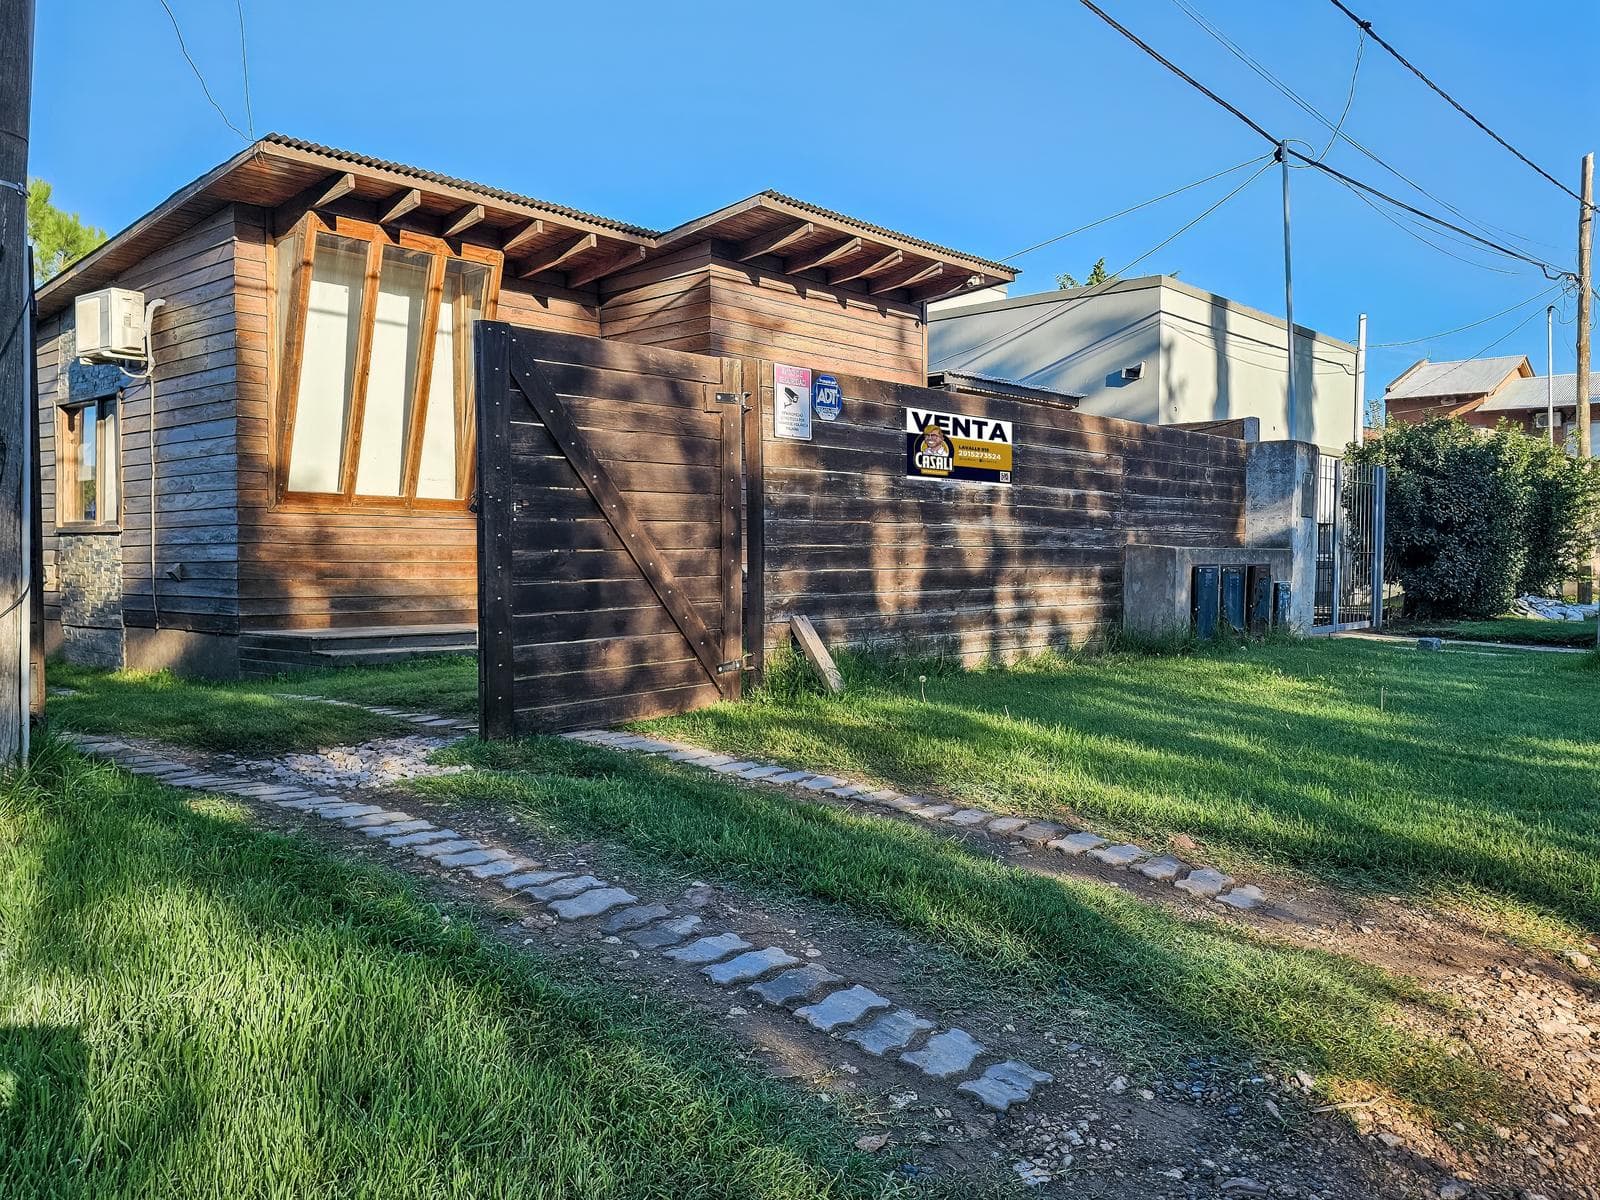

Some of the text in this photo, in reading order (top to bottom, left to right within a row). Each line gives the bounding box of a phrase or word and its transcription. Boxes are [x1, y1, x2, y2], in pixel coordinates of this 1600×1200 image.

[817, 388, 836, 404] ADT
[912, 412, 1008, 442] VENTA
[915, 452, 953, 471] CASALI
